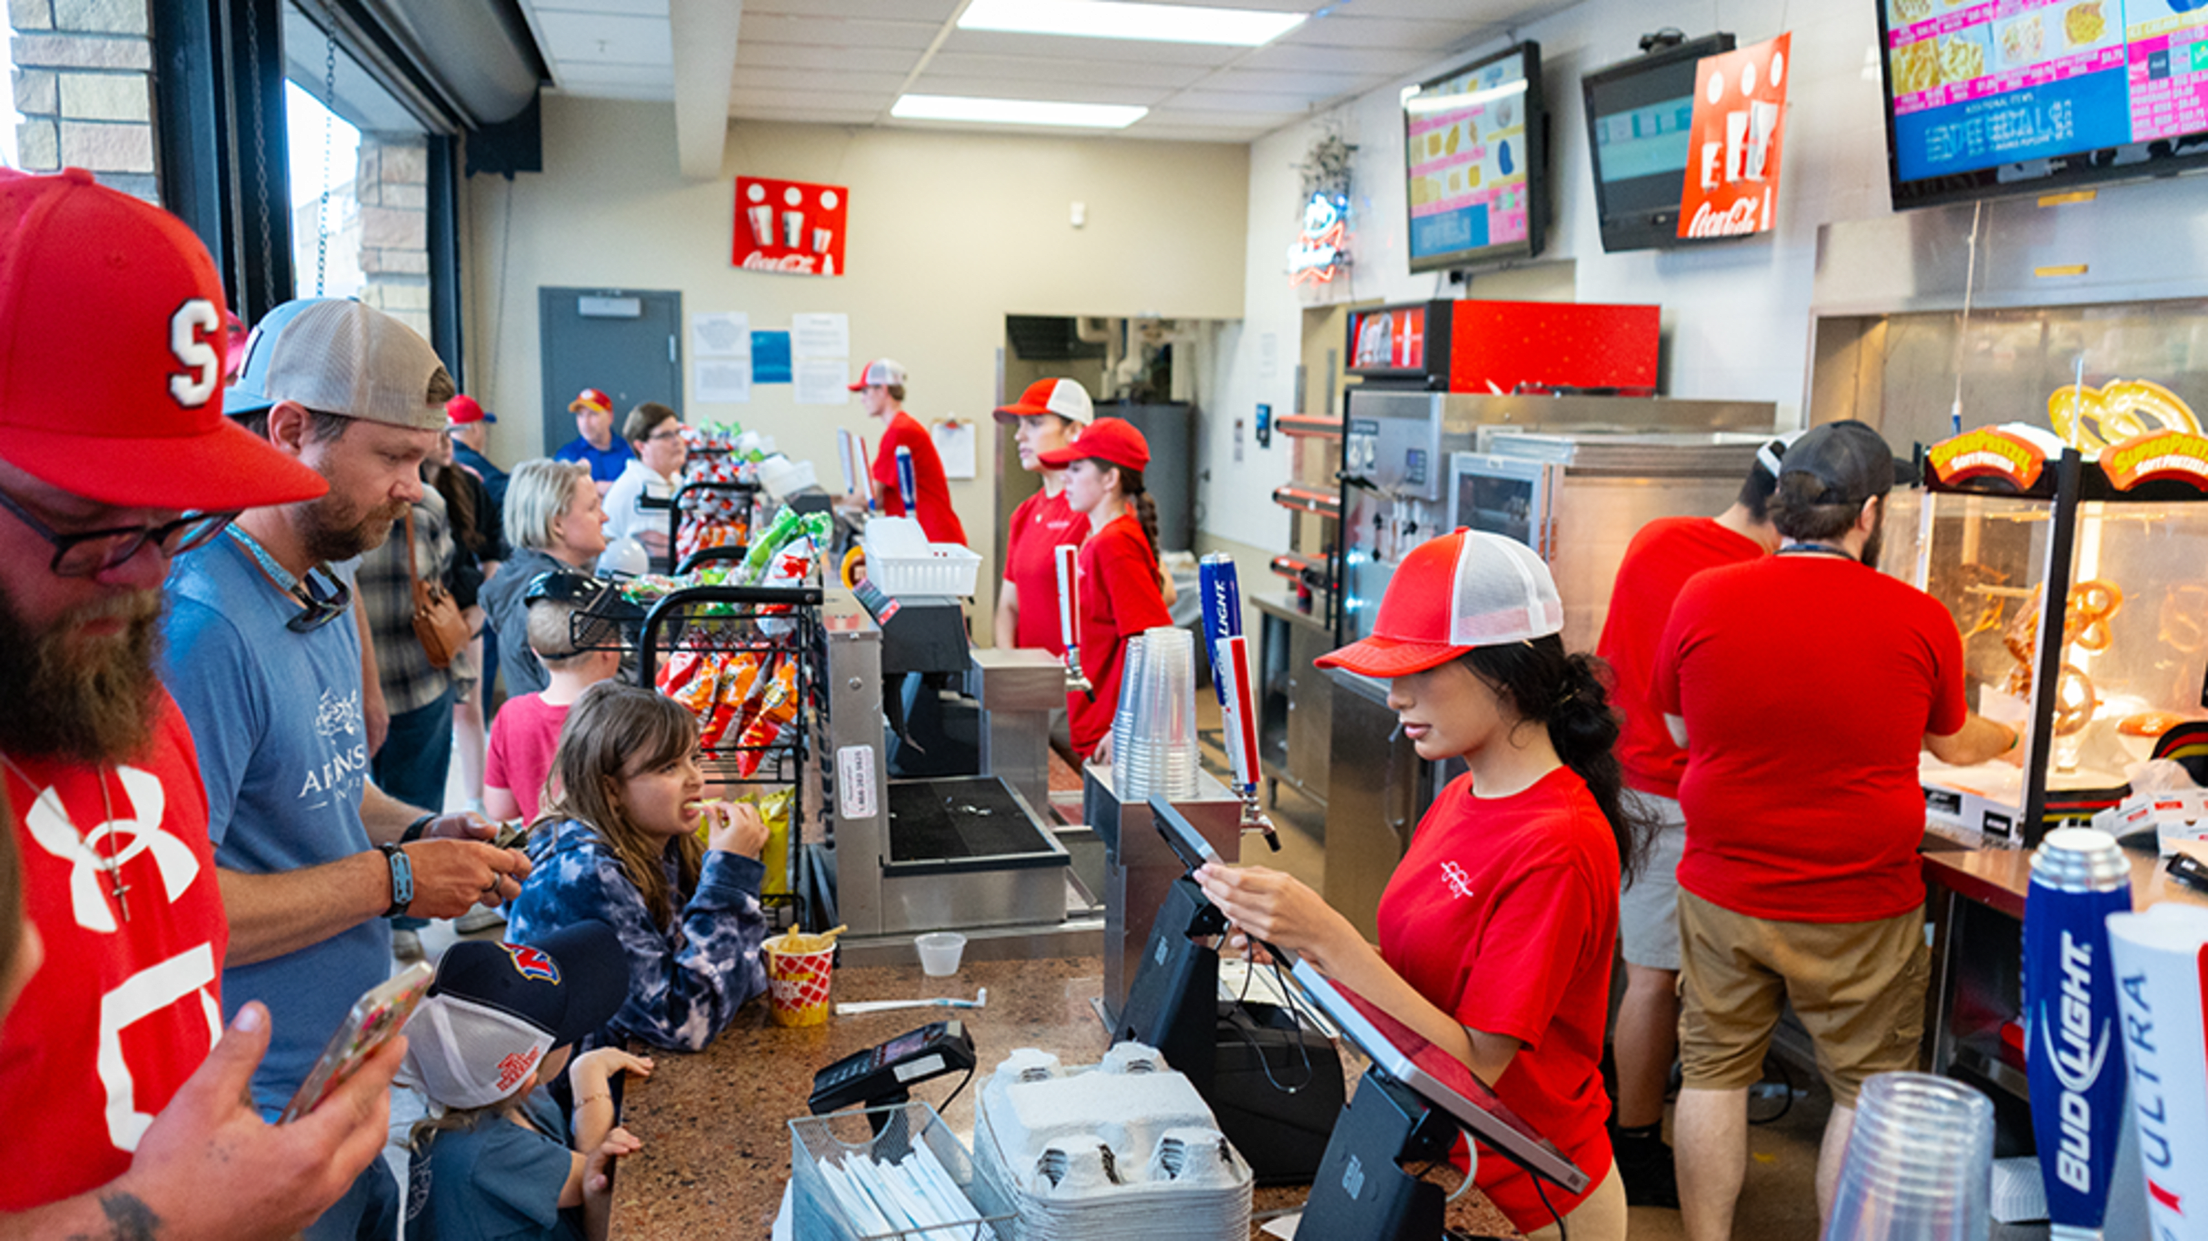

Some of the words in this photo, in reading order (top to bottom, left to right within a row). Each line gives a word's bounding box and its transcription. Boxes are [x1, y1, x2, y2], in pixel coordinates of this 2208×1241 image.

[169, 298, 220, 408] S
[1930, 429, 2032, 473] SUPERPRETZEL
[2113, 433, 2208, 475] SUPERPRET
[1213, 579, 1230, 637] LIGHT
[2058, 929, 2093, 1068] LIGHT
[2121, 969, 2172, 1169] ULTRA
[2056, 1092, 2091, 1195] BUD
